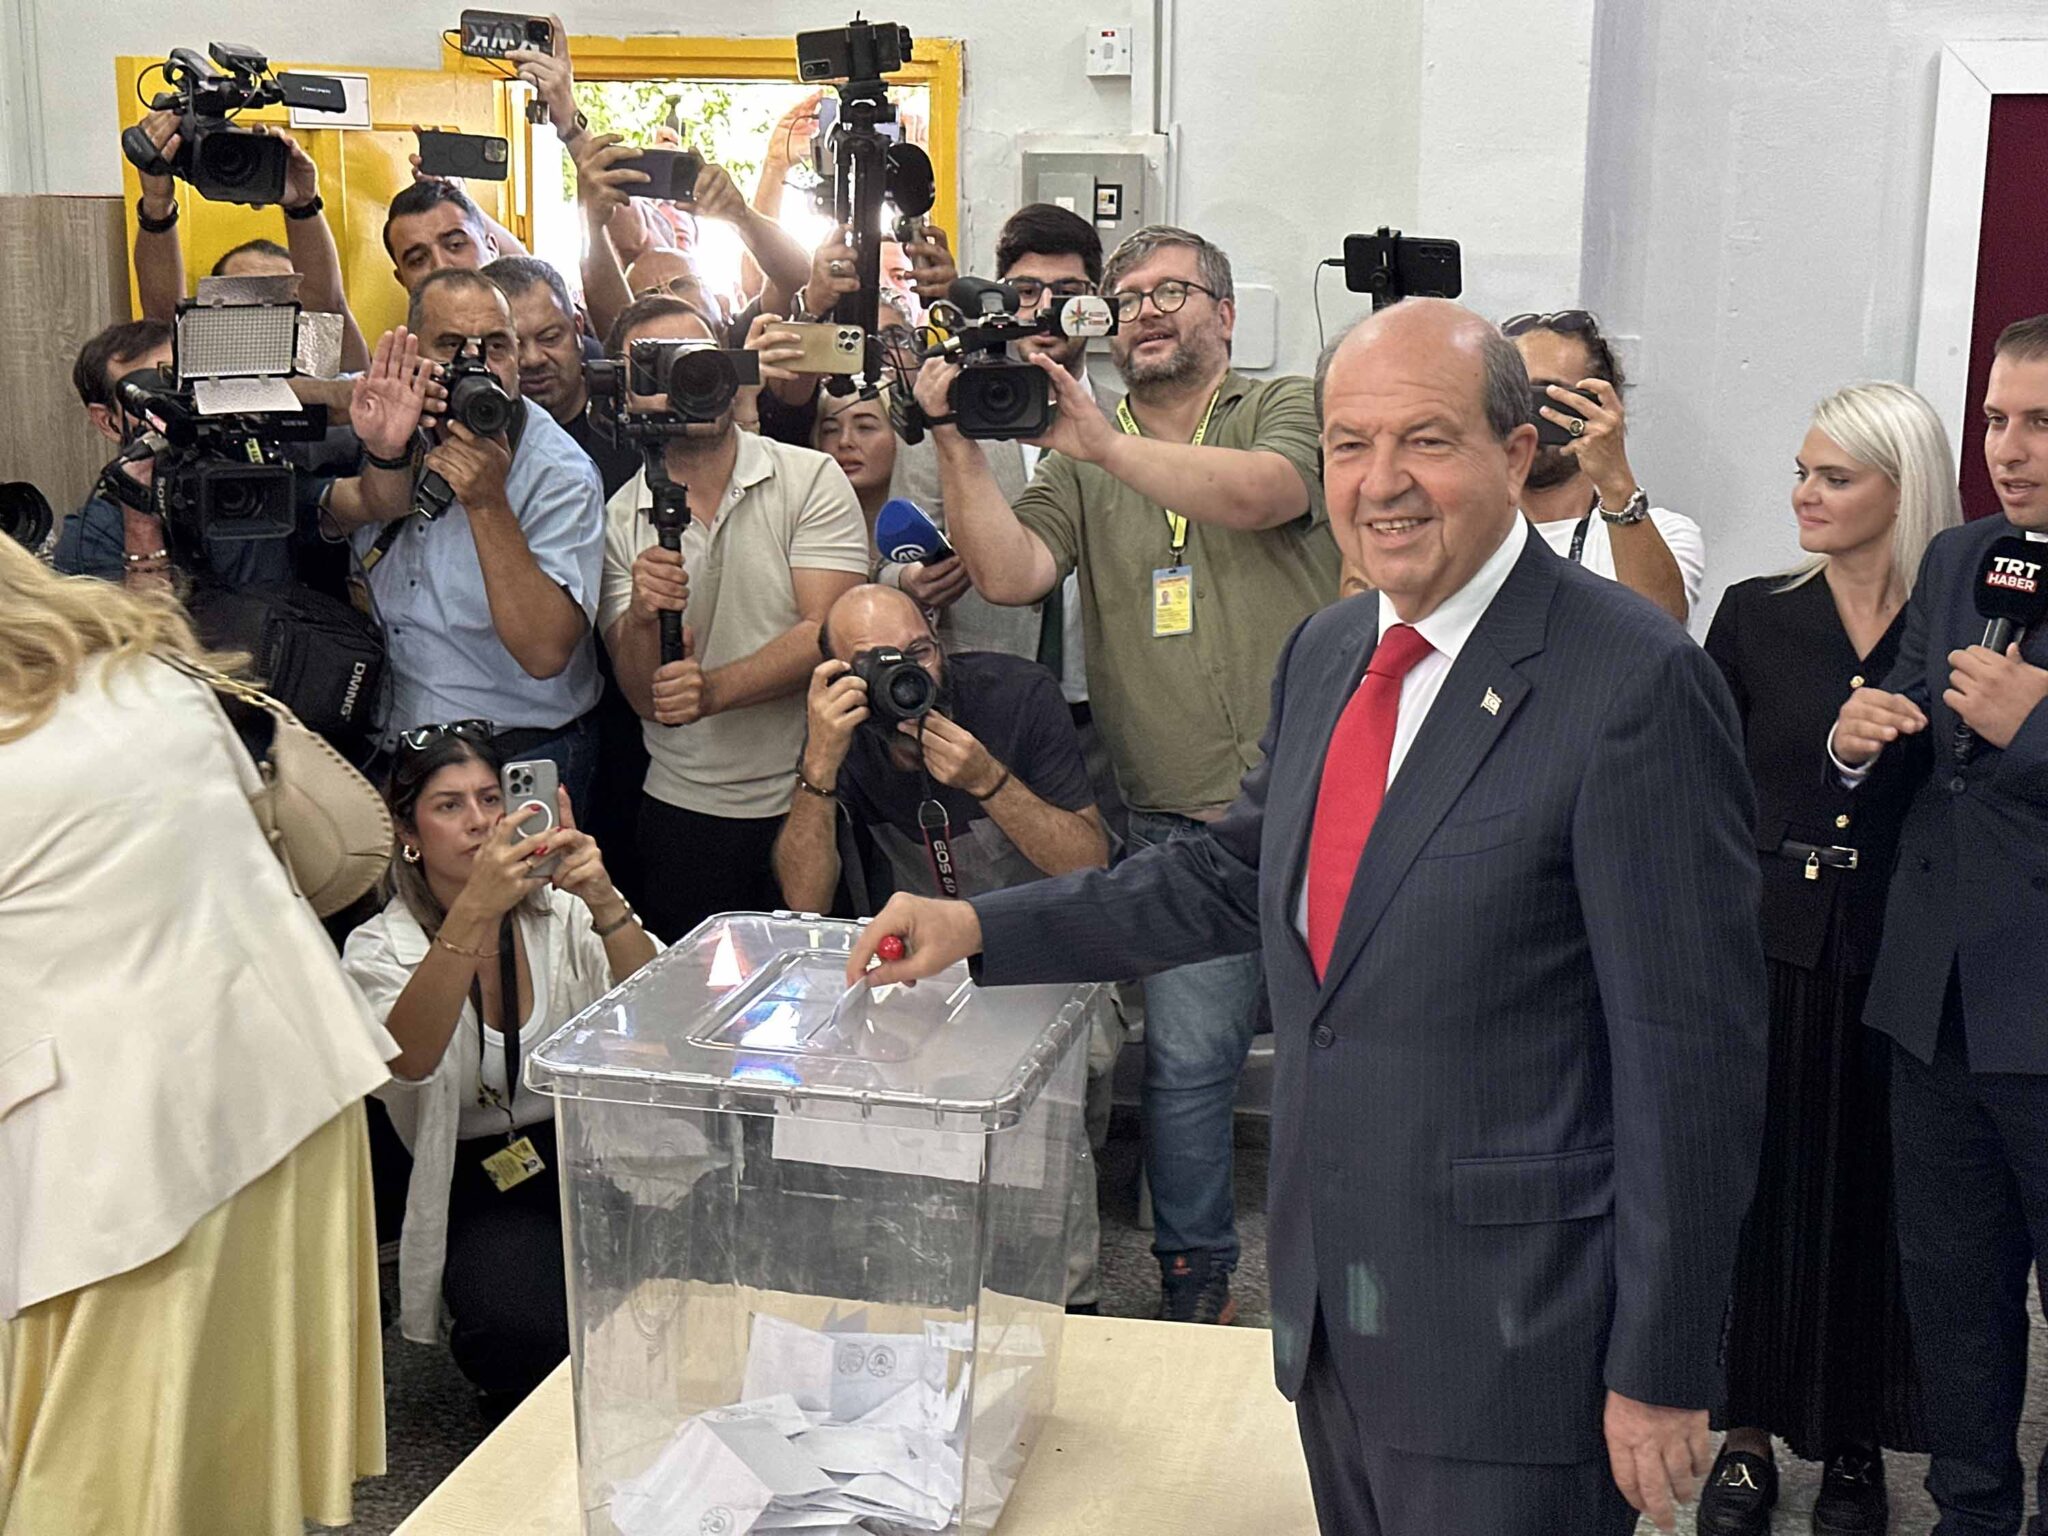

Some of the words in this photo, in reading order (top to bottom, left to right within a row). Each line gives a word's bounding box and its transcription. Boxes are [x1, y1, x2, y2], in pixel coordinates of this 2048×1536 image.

[157, 477, 168, 520] SONY
[1994, 556, 2042, 579] TRT
[1987, 573, 2036, 592] HABER
[340, 661, 366, 716] DMNG
[933, 840, 952, 874] EOS
[942, 877, 956, 894] 6D
